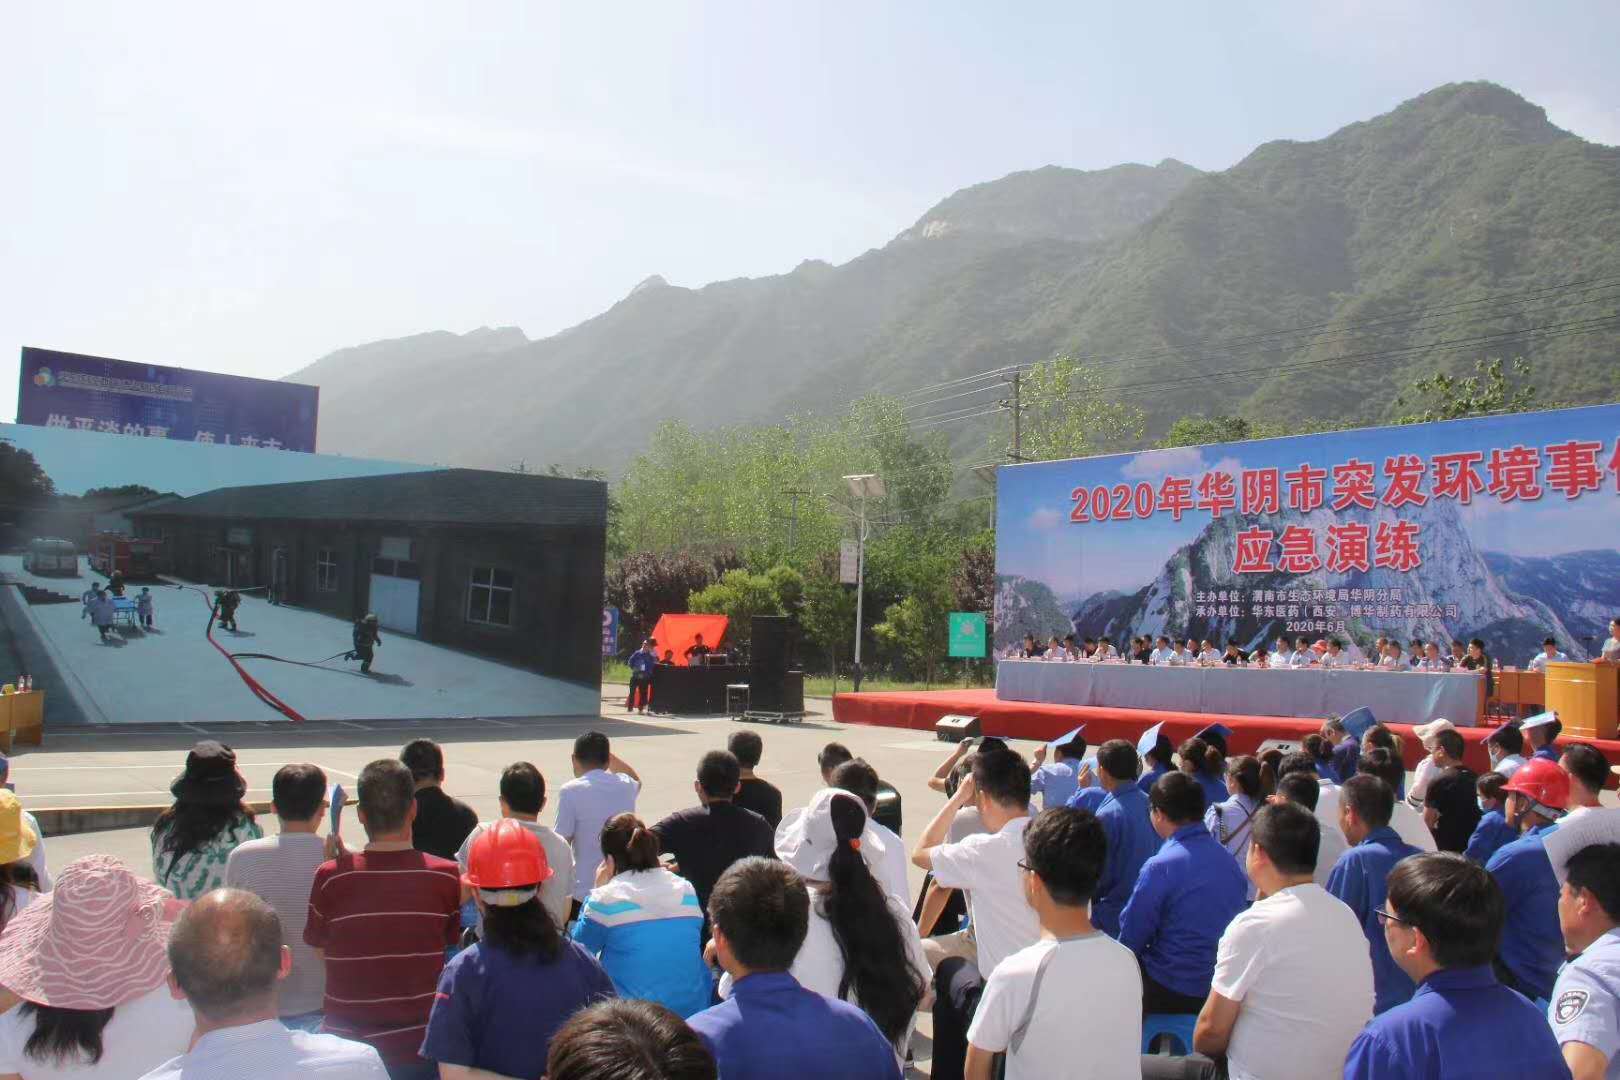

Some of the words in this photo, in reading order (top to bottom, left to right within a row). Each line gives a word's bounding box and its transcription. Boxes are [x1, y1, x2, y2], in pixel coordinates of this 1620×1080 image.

[1233, 520, 1421, 574] 应急演练
[1286, 620, 1345, 633] 2020年6月
